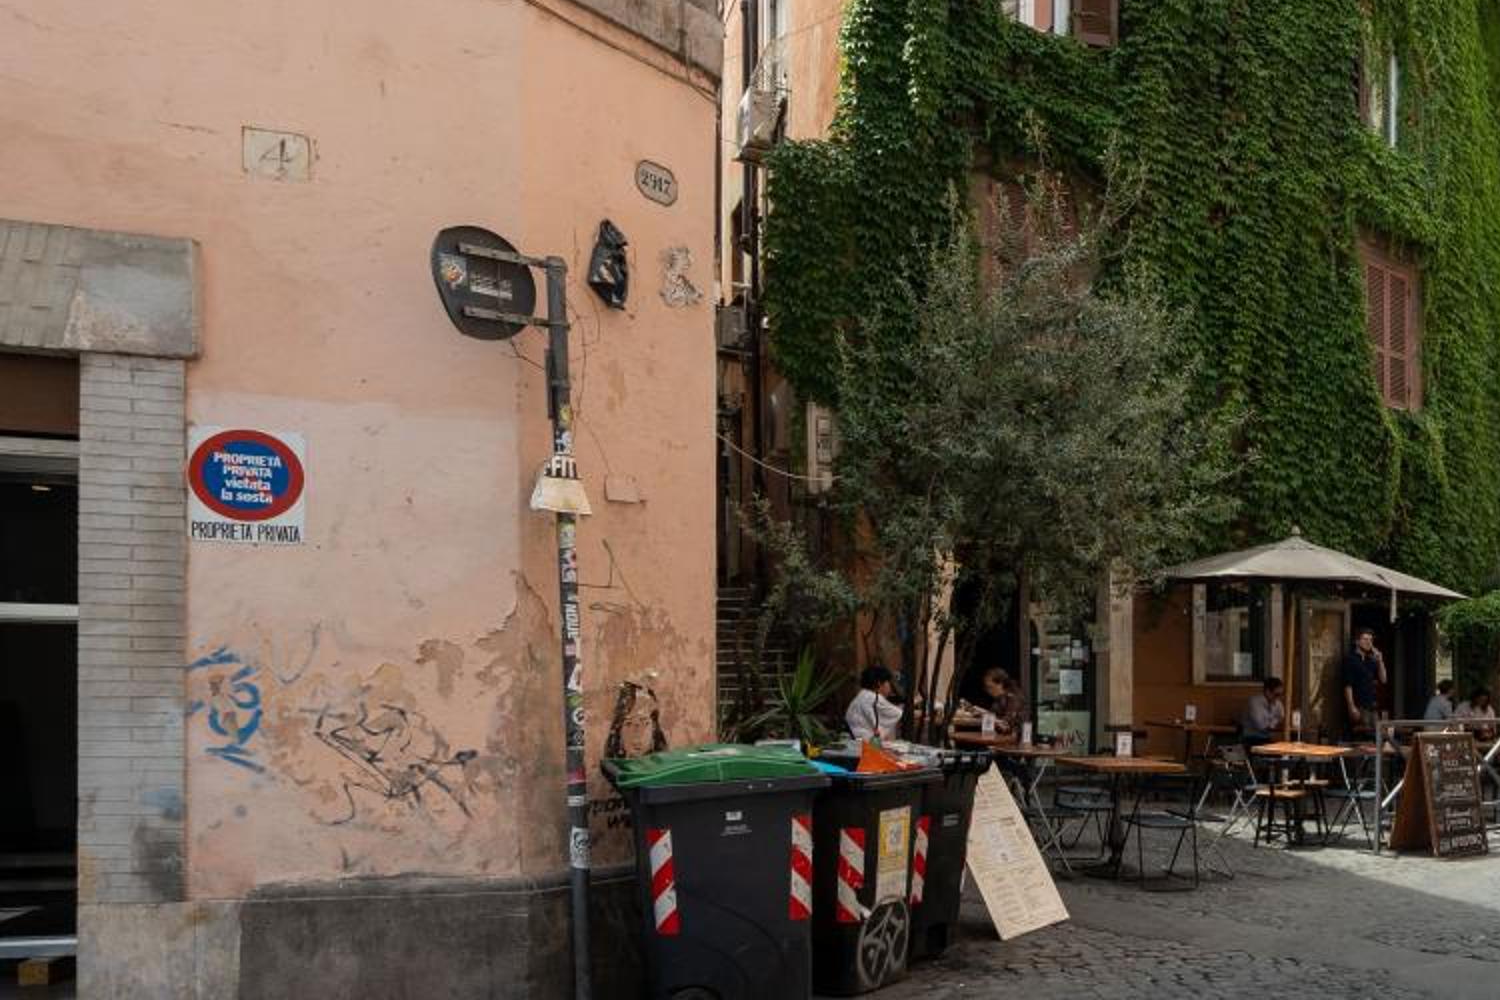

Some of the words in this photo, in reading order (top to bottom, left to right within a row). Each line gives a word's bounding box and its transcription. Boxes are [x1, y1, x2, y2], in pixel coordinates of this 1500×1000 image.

[223, 465, 273, 478] PRIVATA
[224, 477, 272, 491] vietata
[221, 487, 233, 500] la
[235, 490, 273, 504] sosta
[257, 525, 302, 543] PRIVATA
